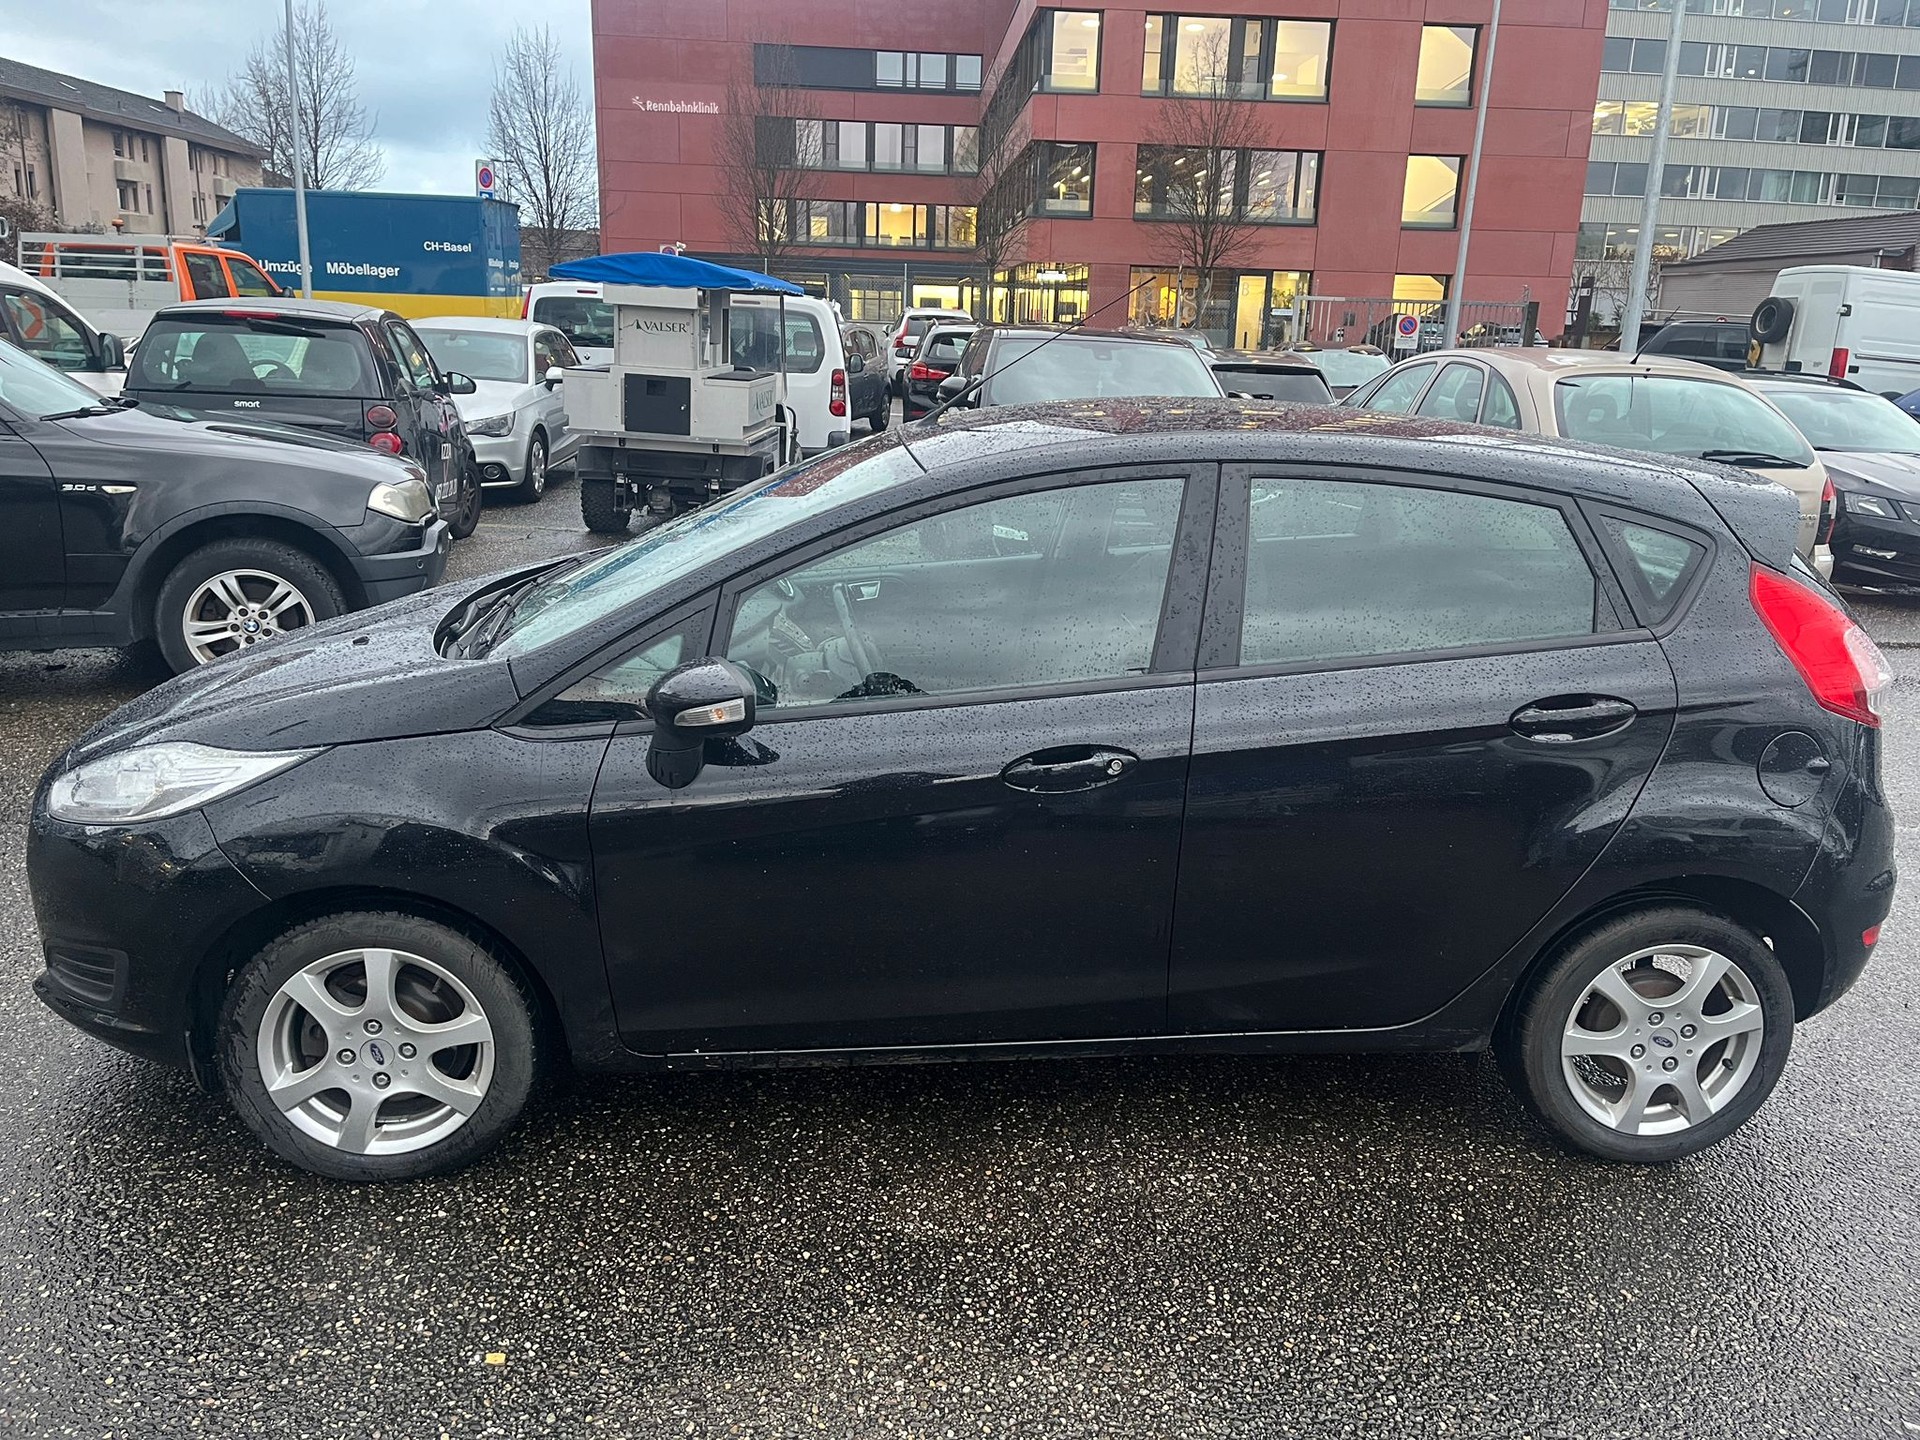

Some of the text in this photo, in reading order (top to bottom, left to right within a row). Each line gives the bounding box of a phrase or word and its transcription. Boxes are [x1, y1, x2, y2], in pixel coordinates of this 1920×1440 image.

[646, 100, 719, 114] Rennbahnklinik
[423, 241, 472, 252] CH-Basel
[326, 262, 400, 278] Möbellager
[643, 320, 687, 333] VALSER
[233, 400, 261, 408] smart
